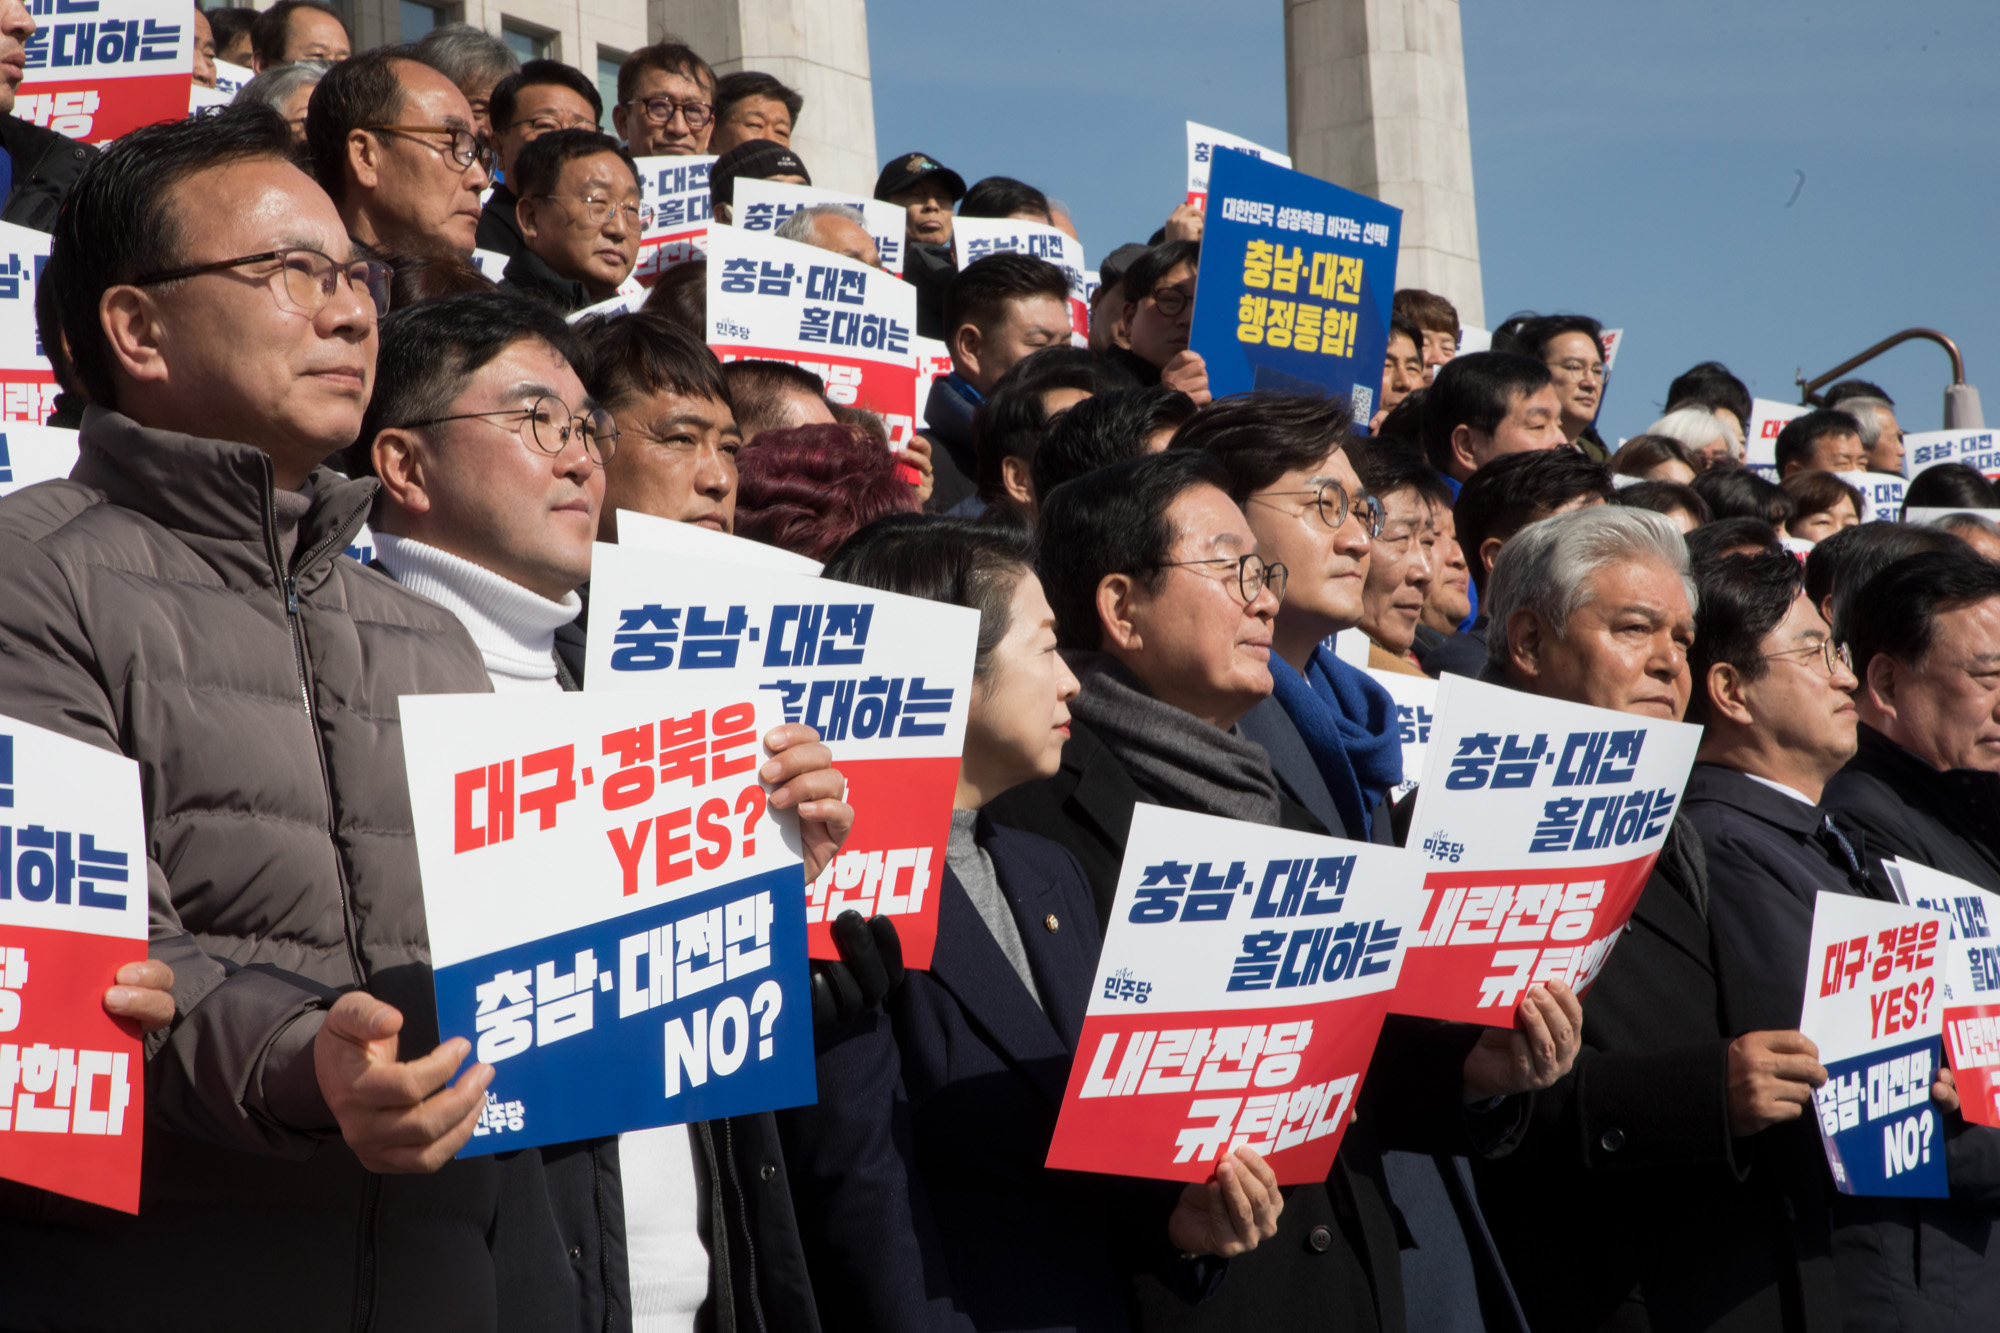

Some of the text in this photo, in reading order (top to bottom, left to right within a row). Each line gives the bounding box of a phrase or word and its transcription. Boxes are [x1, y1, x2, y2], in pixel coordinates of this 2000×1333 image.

[1222, 197, 1275, 228] 대한민국
[1327, 215, 1361, 241] 바꾸는
[1363, 222, 1389, 247] 선택!
[720, 258, 867, 306] 충남·대전
[1243, 239, 1363, 304] 충남·대전
[799, 307, 910, 355] 홀대하는
[1236, 294, 1358, 358] 행정통합!
[611, 604, 875, 672] 충남·대전
[454, 702, 758, 855] 대구·경북은
[1445, 729, 1648, 791] 충남·대전
[606, 784, 767, 897] YES?
[1528, 788, 1677, 854] 홀대하는
[0, 825, 129, 911] 하는
[1128, 855, 1358, 925] 충남·대전
[1418, 880, 1606, 948] 내란잔당
[475, 890, 774, 1065] 충남·대전만
[1103, 976, 1153, 1005] 민주당
[1226, 919, 1403, 993] 홀대하는
[1819, 920, 1940, 999] 대구·경북은
[1967, 944, 2000, 993] 홀대
[664, 980, 783, 1099] NO?
[1870, 976, 1935, 1040] YES?
[1079, 1019, 1314, 1099] 내란잔당
[1817, 1048, 1932, 1137] 충남·대전만
[1172, 1073, 1360, 1164] 규탄한다
[1884, 1109, 1934, 1179] NO?
